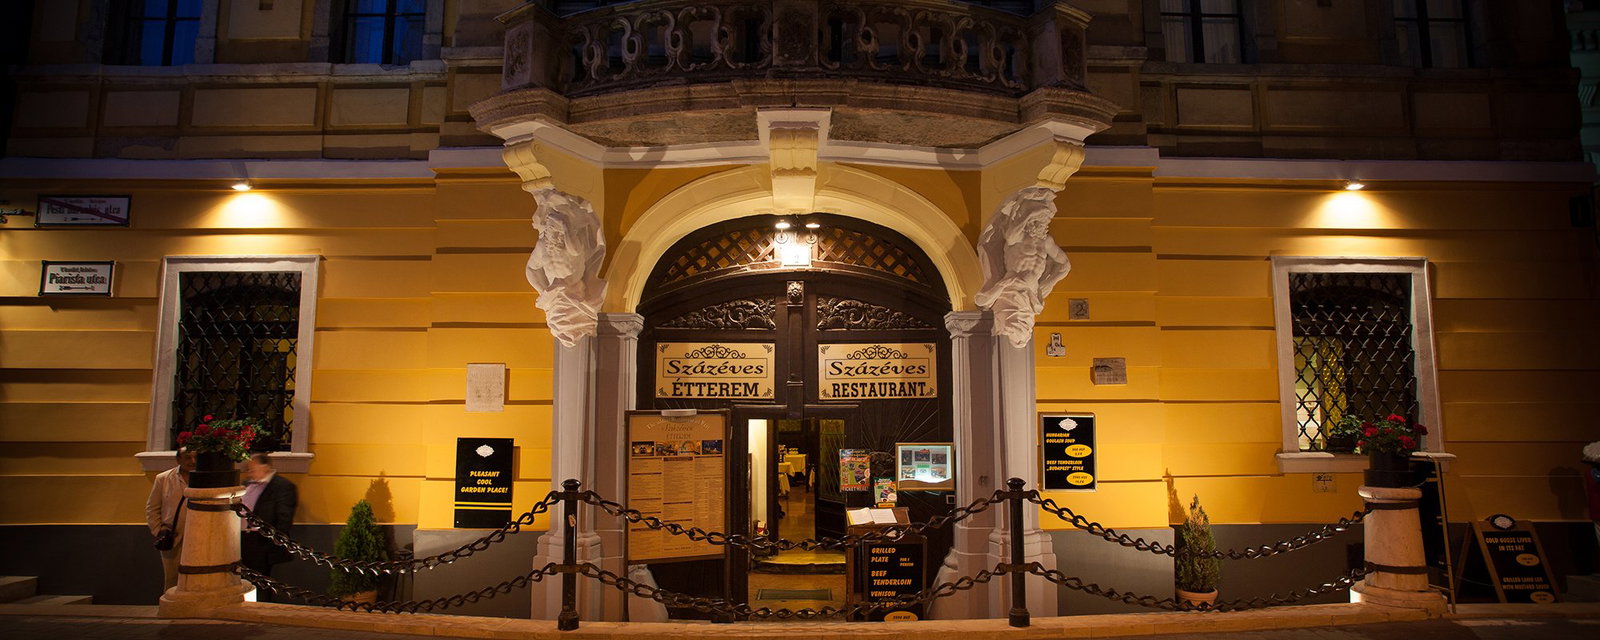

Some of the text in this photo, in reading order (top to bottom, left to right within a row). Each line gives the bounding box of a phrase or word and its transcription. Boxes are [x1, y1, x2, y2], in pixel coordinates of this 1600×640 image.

[49, 273, 107, 285] Piarista utca
[666, 359, 764, 377] Százéves
[828, 360, 927, 378] Százéves
[671, 378, 759, 398] ÉTTEREM
[831, 381, 927, 398] RESTAURANT
